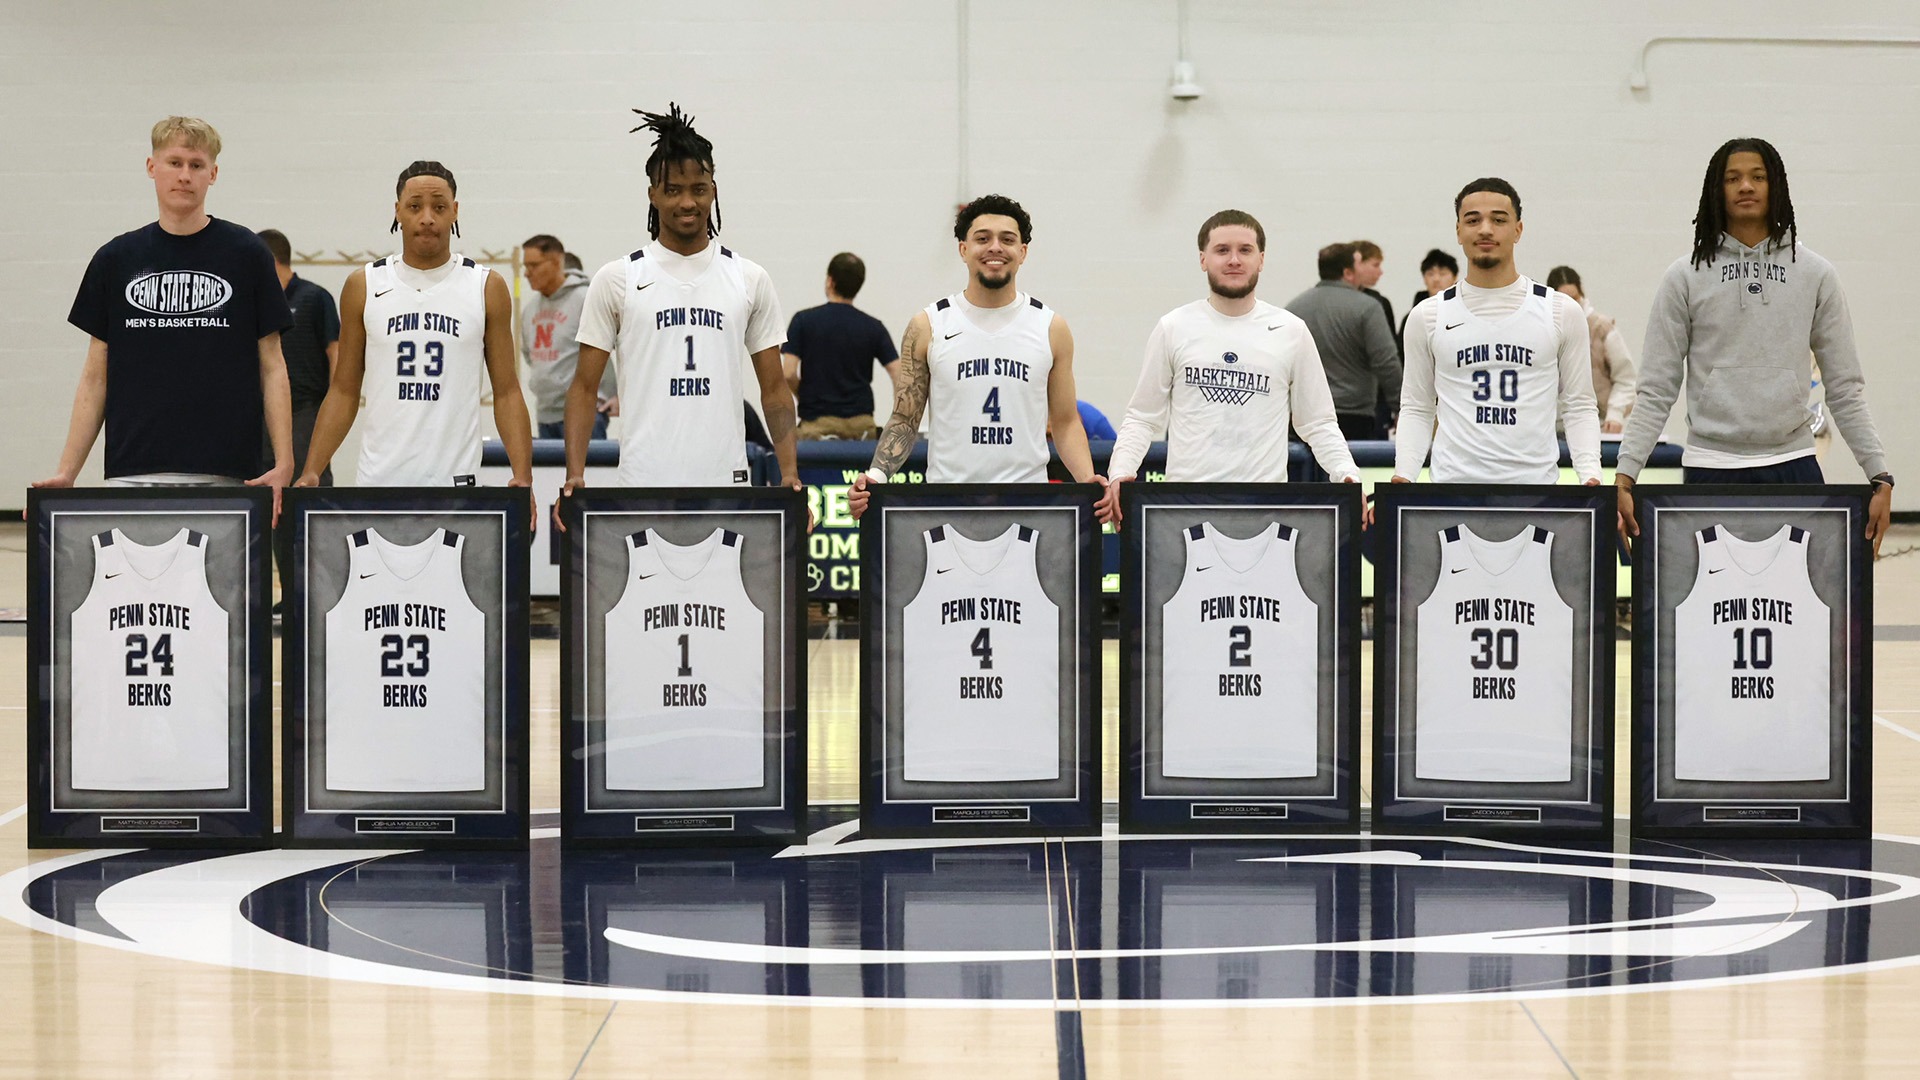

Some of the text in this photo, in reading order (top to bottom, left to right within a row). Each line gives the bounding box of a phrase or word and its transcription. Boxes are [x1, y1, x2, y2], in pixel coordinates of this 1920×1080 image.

[1721, 261, 1786, 283] PENN SATE
[133, 273, 223, 312] PENN STATE BERKS
[125, 317, 230, 329] MEN'S BASKETBALL
[387, 312, 460, 338] PENN STATE
[656, 307, 724, 332] PENN STATE
[534, 322, 555, 349] N
[396, 340, 445, 378] 23
[684, 334, 697, 372] 1
[1456, 343, 1533, 368] PENN STATE
[957, 357, 1029, 383] PENN STATE
[1184, 366, 1271, 393] BASKETBALL
[398, 382, 441, 402] BERKS
[669, 377, 711, 397] BERKS
[1470, 368, 1520, 403] 30
[981, 385, 1002, 423] 4
[1475, 405, 1517, 426] BERKS
[971, 426, 1013, 446] BERKS
[908, 471, 924, 484] to
[109, 602, 190, 631] PENN STATE
[364, 603, 446, 632] PENN STATE
[644, 603, 726, 632] PENN STATE
[941, 597, 1021, 625] PENN STATE
[1200, 595, 1280, 623] PENN STATE
[1455, 597, 1535, 627] PENN STATE
[1713, 597, 1793, 625] PENN STATE
[125, 632, 175, 678] 24
[379, 633, 431, 679] 23
[676, 633, 693, 678] 1
[969, 626, 994, 671] 4
[1228, 624, 1253, 668] 2
[1470, 627, 1520, 672] 30
[1731, 627, 1774, 671] 10
[128, 683, 172, 707] BERKS
[383, 684, 427, 708] BERKS
[663, 683, 707, 707] BERKS
[960, 676, 1003, 700] BERKS
[1219, 673, 1262, 697] BERKS
[1472, 676, 1516, 700] BERKS
[1731, 676, 1774, 700] BERKS
